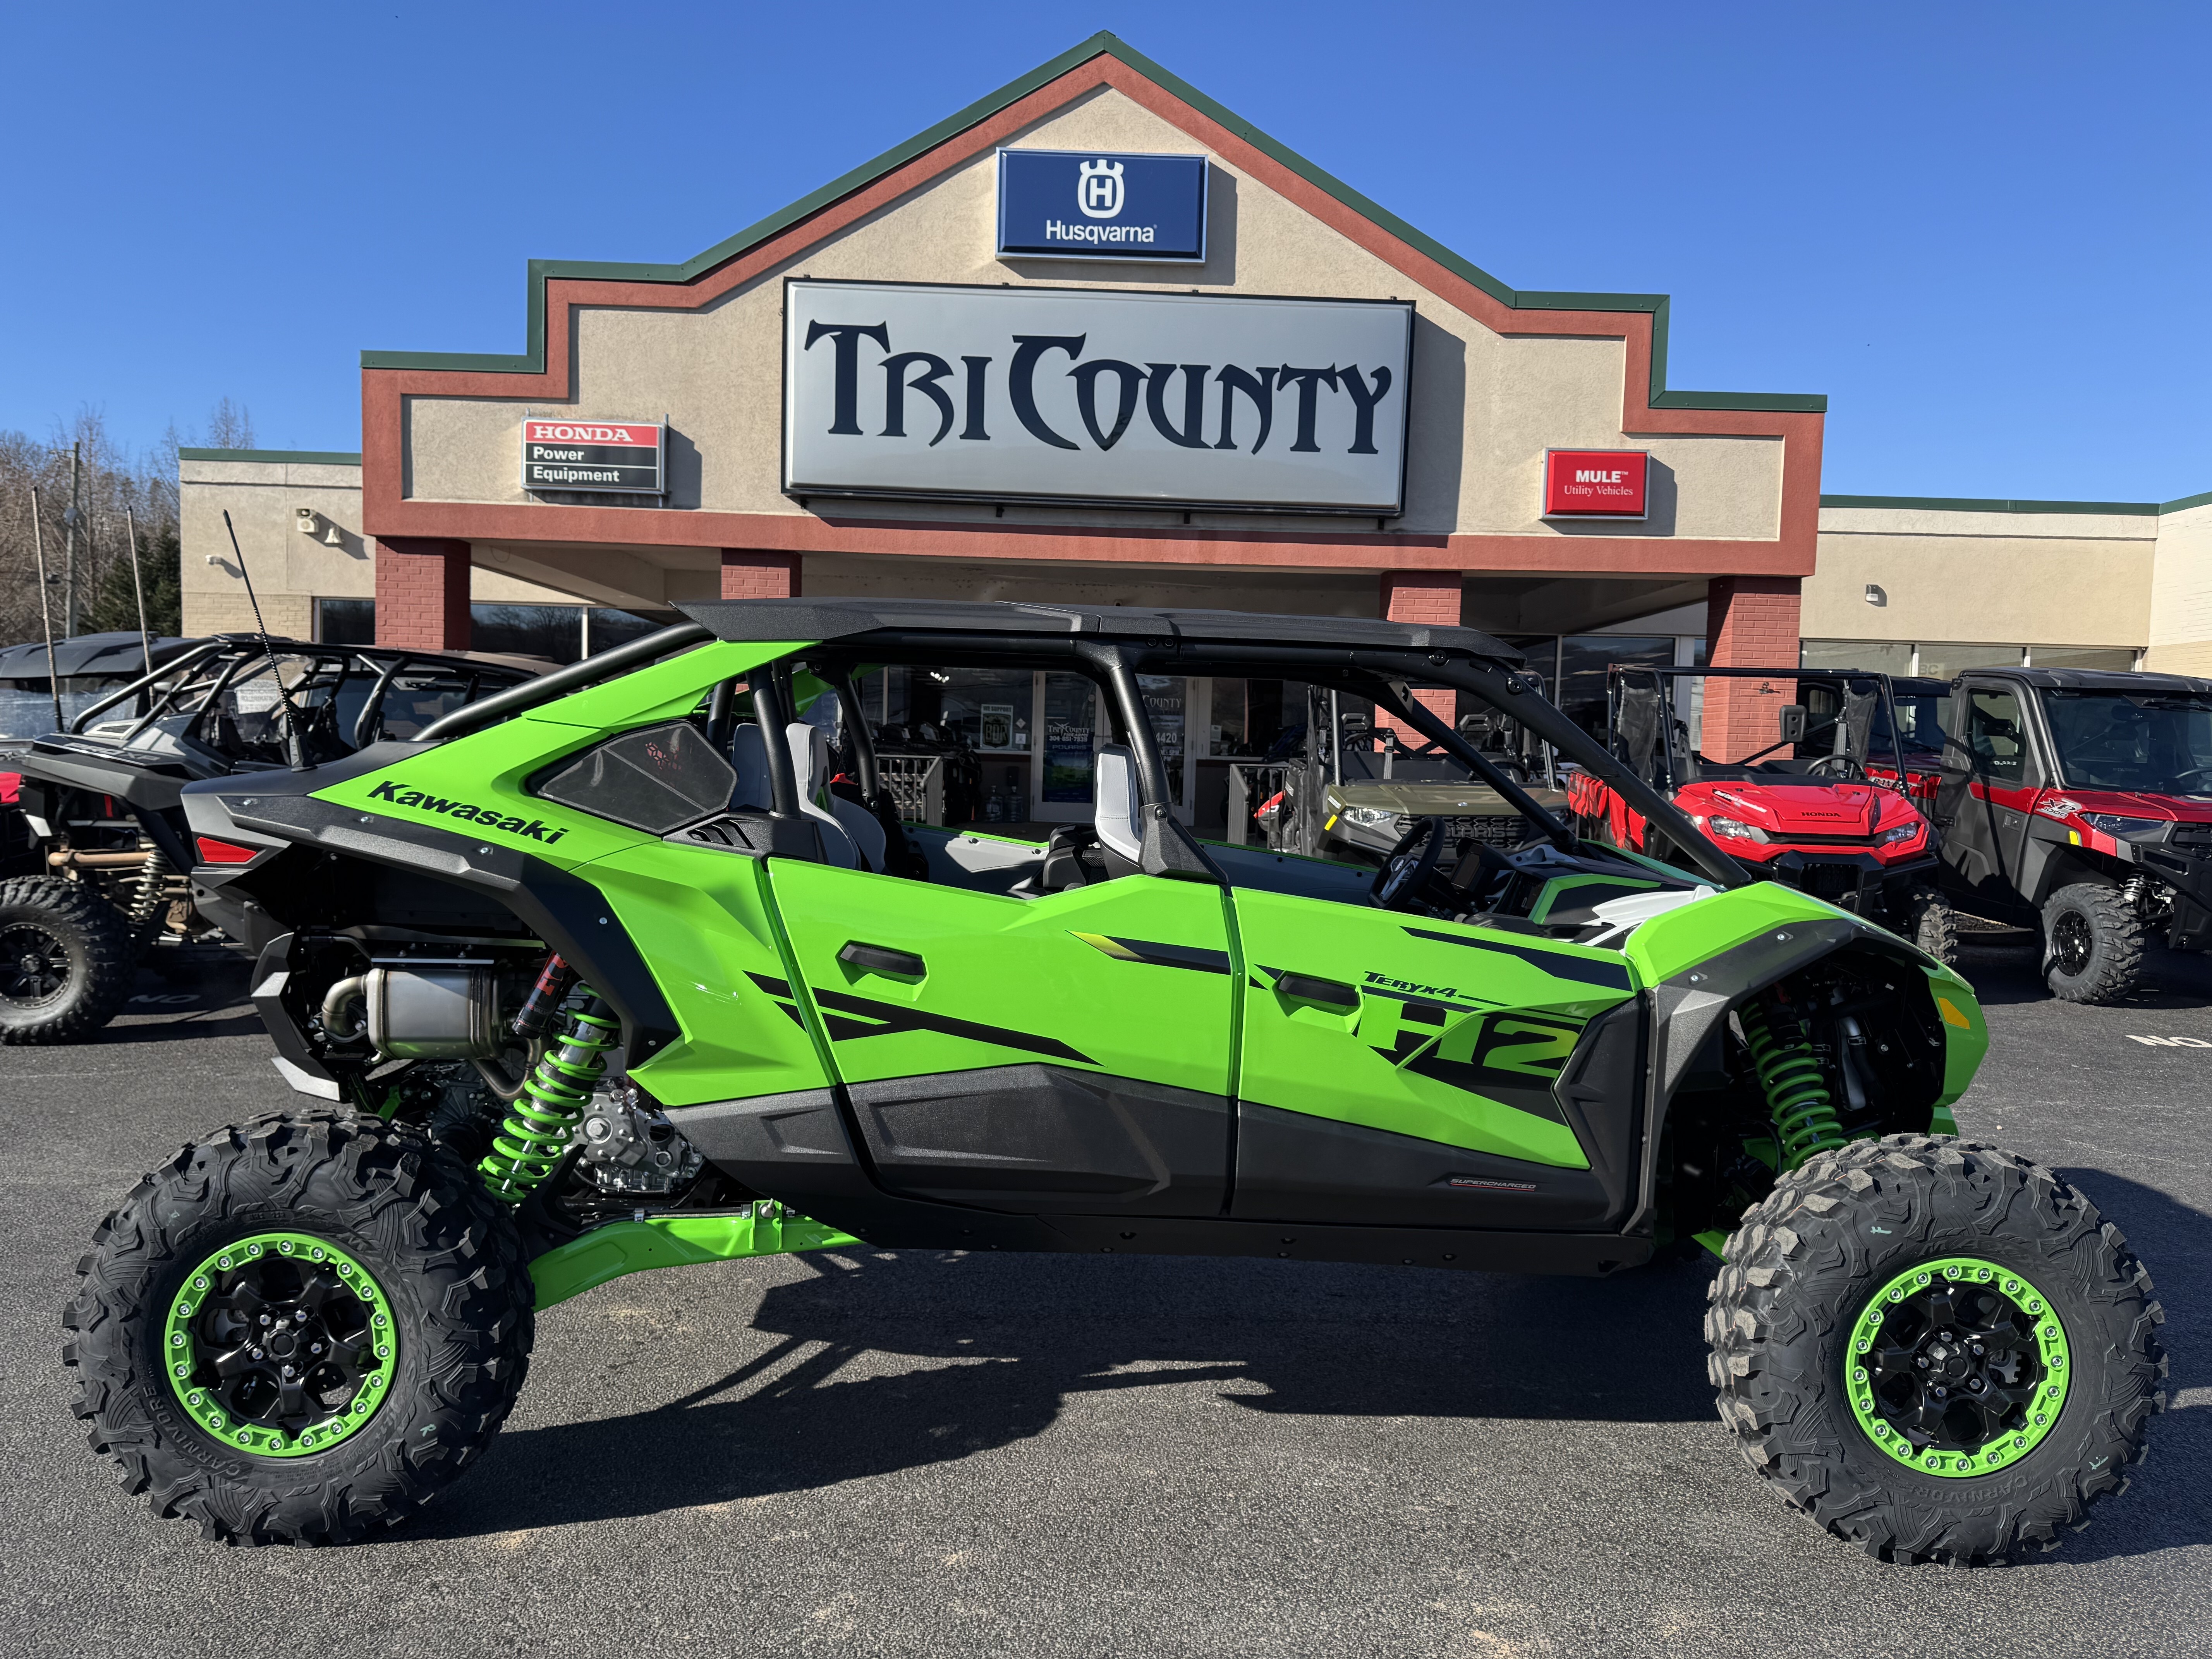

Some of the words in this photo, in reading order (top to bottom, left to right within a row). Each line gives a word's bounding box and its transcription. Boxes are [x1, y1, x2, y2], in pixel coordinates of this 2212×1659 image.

[1046, 220, 1154, 244] Husqvarna
[533, 426, 634, 442] HONDA
[533, 446, 584, 460] Power
[533, 466, 620, 483] Equipment
[1564, 485, 1594, 497] Utility
[1596, 486, 1633, 496] Vehicles
[1142, 695, 1182, 709] COUNTY
[63, 742, 125, 756] PRO
[118, 752, 161, 761] XP
[367, 780, 569, 844] Kawasaki
[2039, 798, 2076, 812] XP
[2044, 807, 2068, 817] 1000
[1445, 825, 1506, 838] LARIS
[537, 953, 569, 996] FO
[2124, 1035, 2212, 1048] NO
[1450, 1178, 1536, 1189] SUPERCHARGED
[142, 1384, 241, 1478] CARNIVORE
